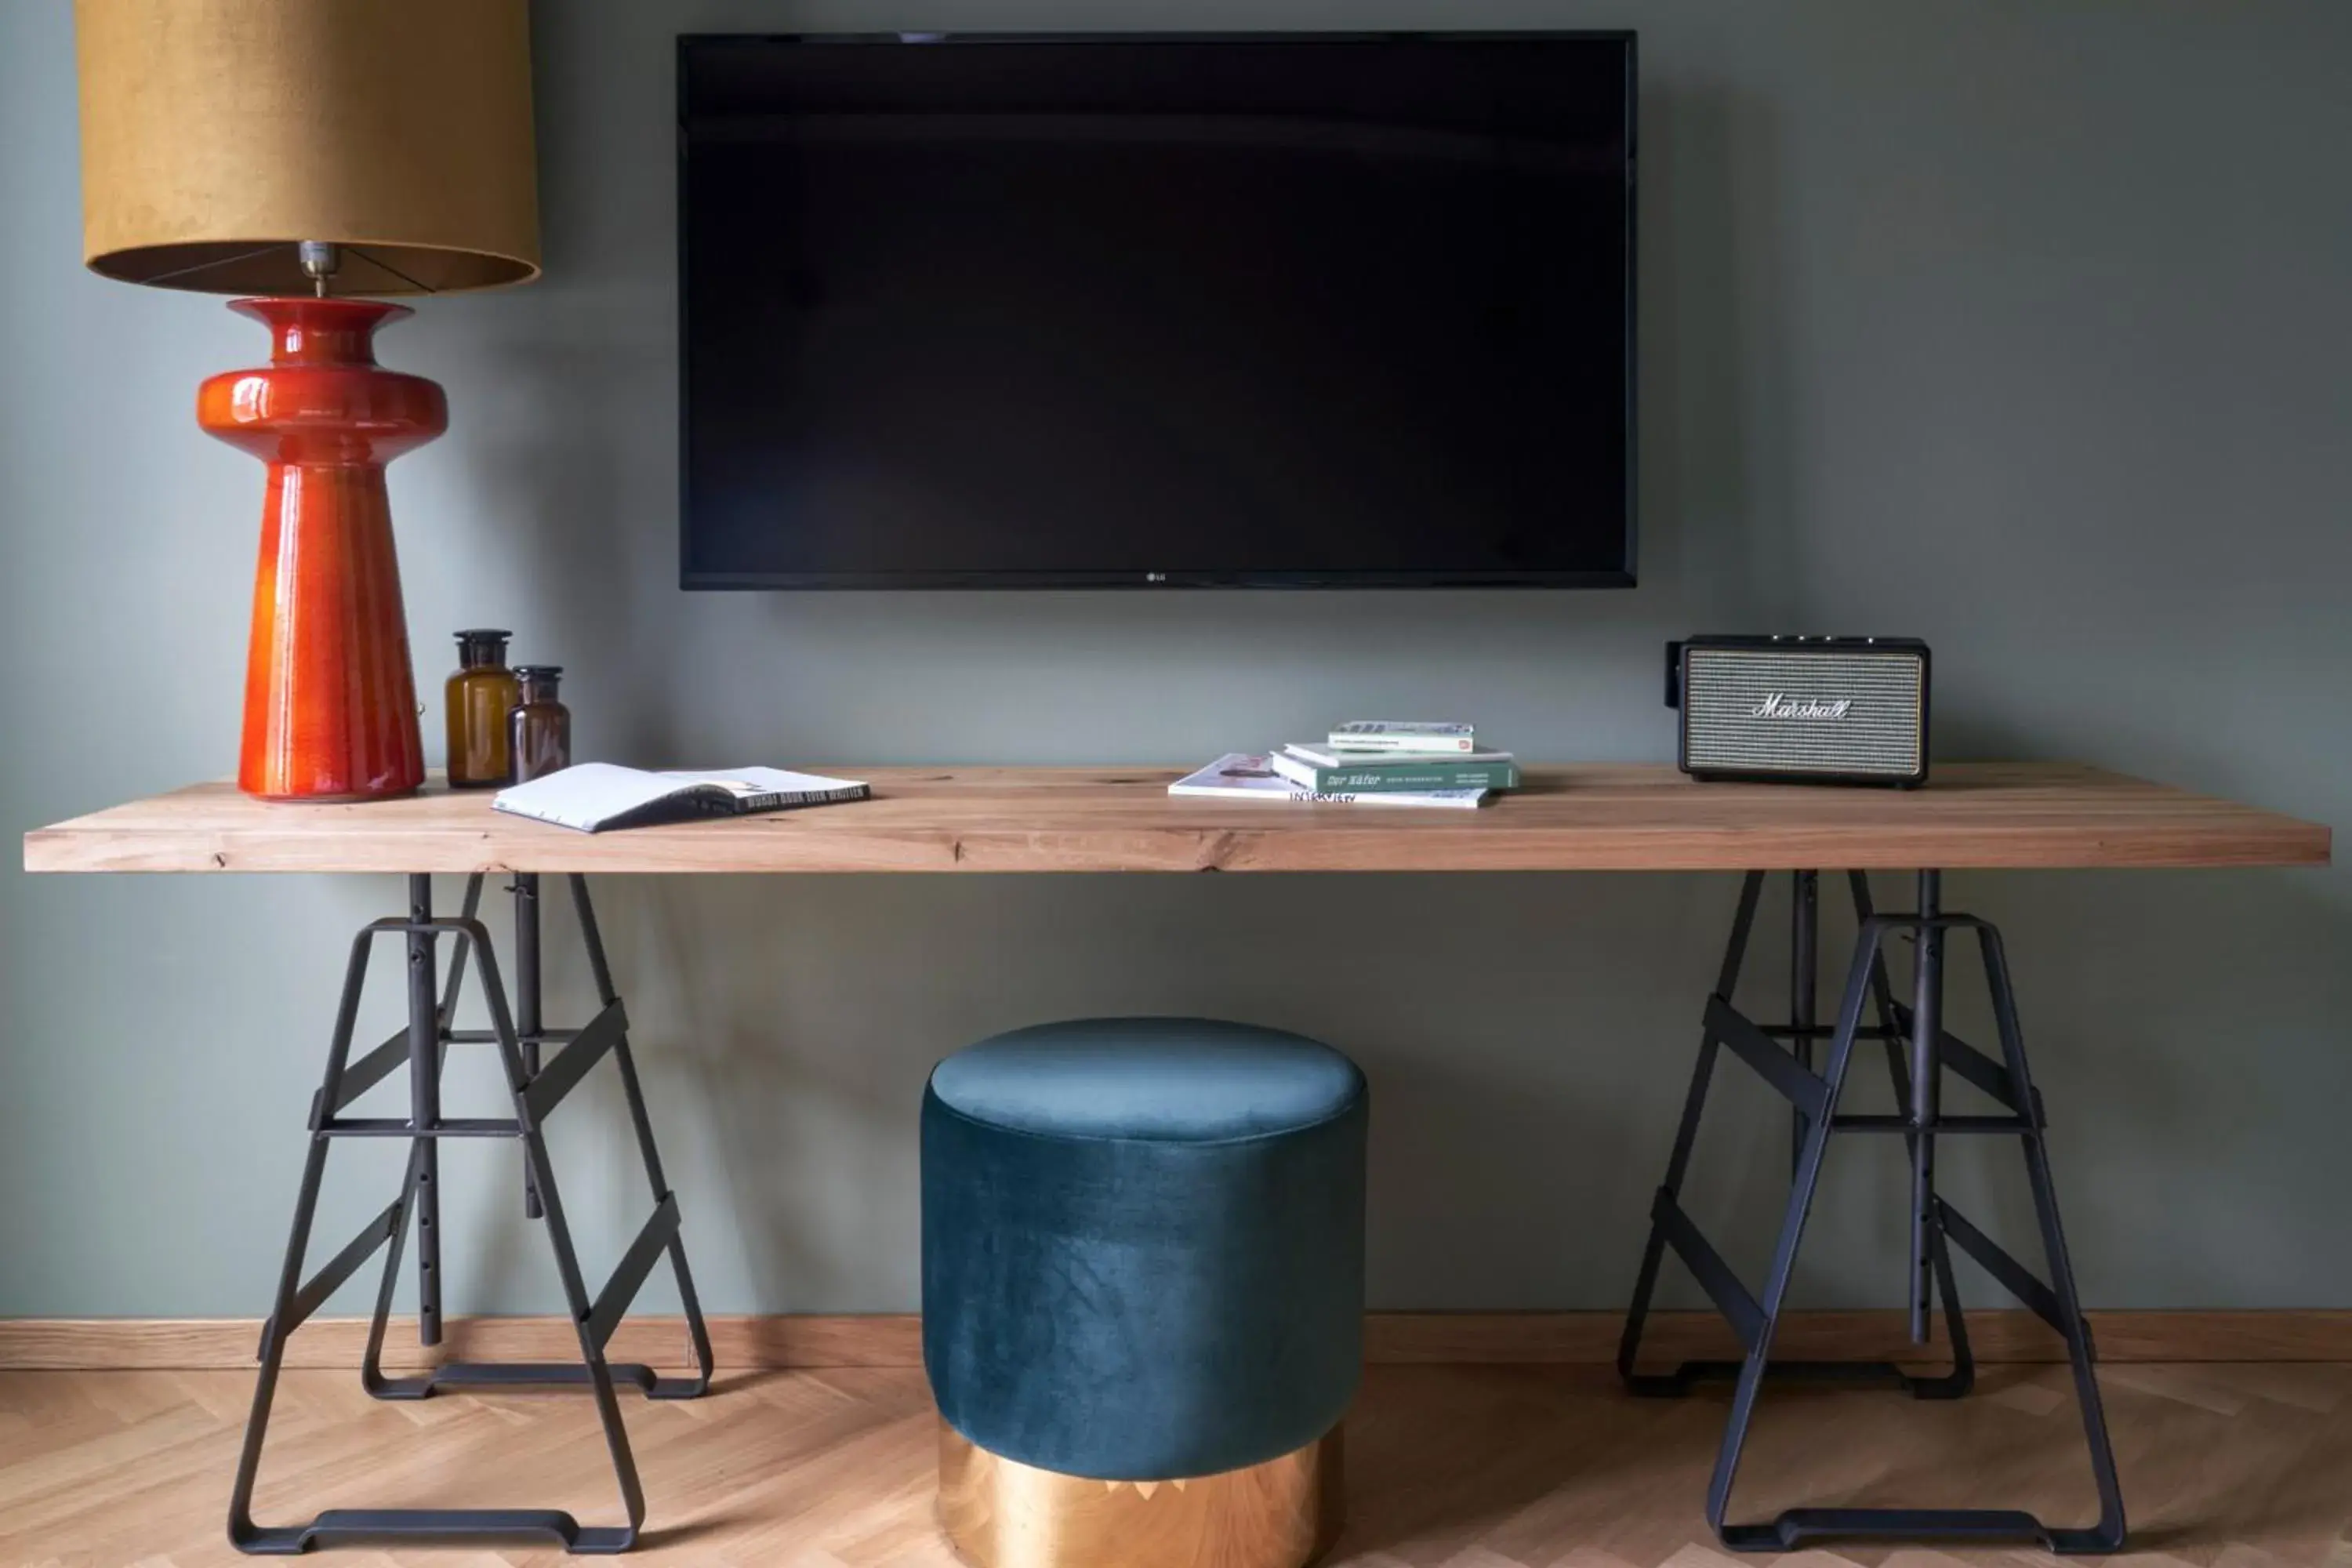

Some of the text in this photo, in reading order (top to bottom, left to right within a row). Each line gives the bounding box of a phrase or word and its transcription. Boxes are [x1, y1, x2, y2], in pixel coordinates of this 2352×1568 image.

[1752, 692, 1852, 720] Marshall
[1327, 775, 1348, 786] Der
[780, 792, 804, 804] BOOK
[806, 790, 827, 803] EVER
